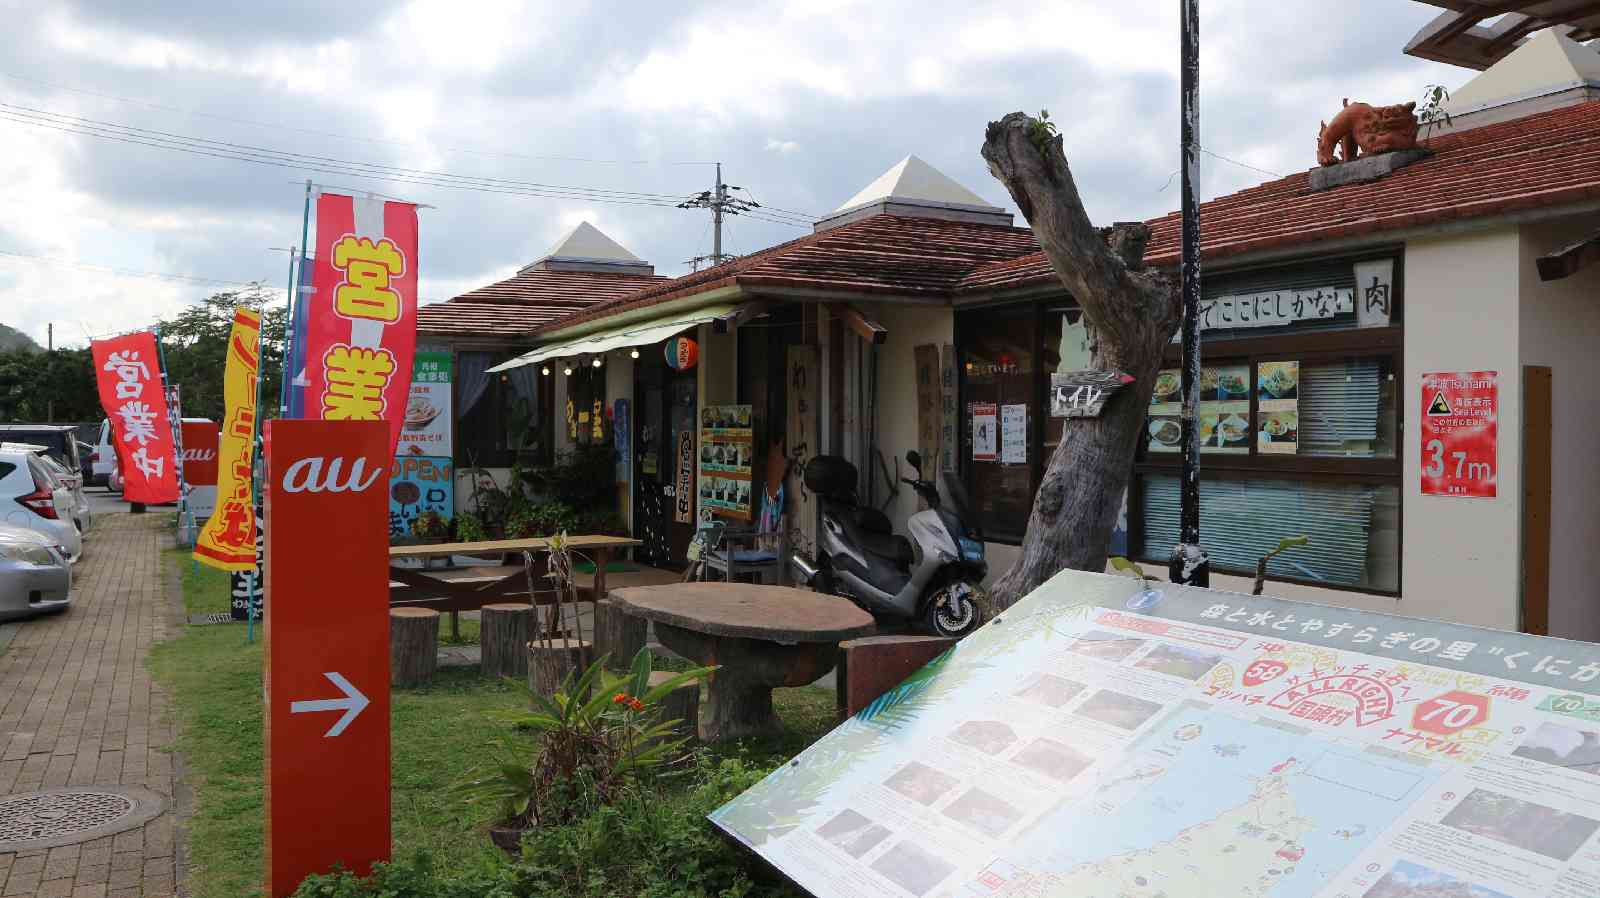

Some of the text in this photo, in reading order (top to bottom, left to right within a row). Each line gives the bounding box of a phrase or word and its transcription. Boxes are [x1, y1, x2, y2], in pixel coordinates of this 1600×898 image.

[103, 350, 164, 481] 営業中
[182, 447, 216, 461] au
[282, 456, 384, 493] au
[1247, 662, 1284, 682] 58
[1420, 698, 1479, 728] 70
[1554, 696, 1582, 711] 70
